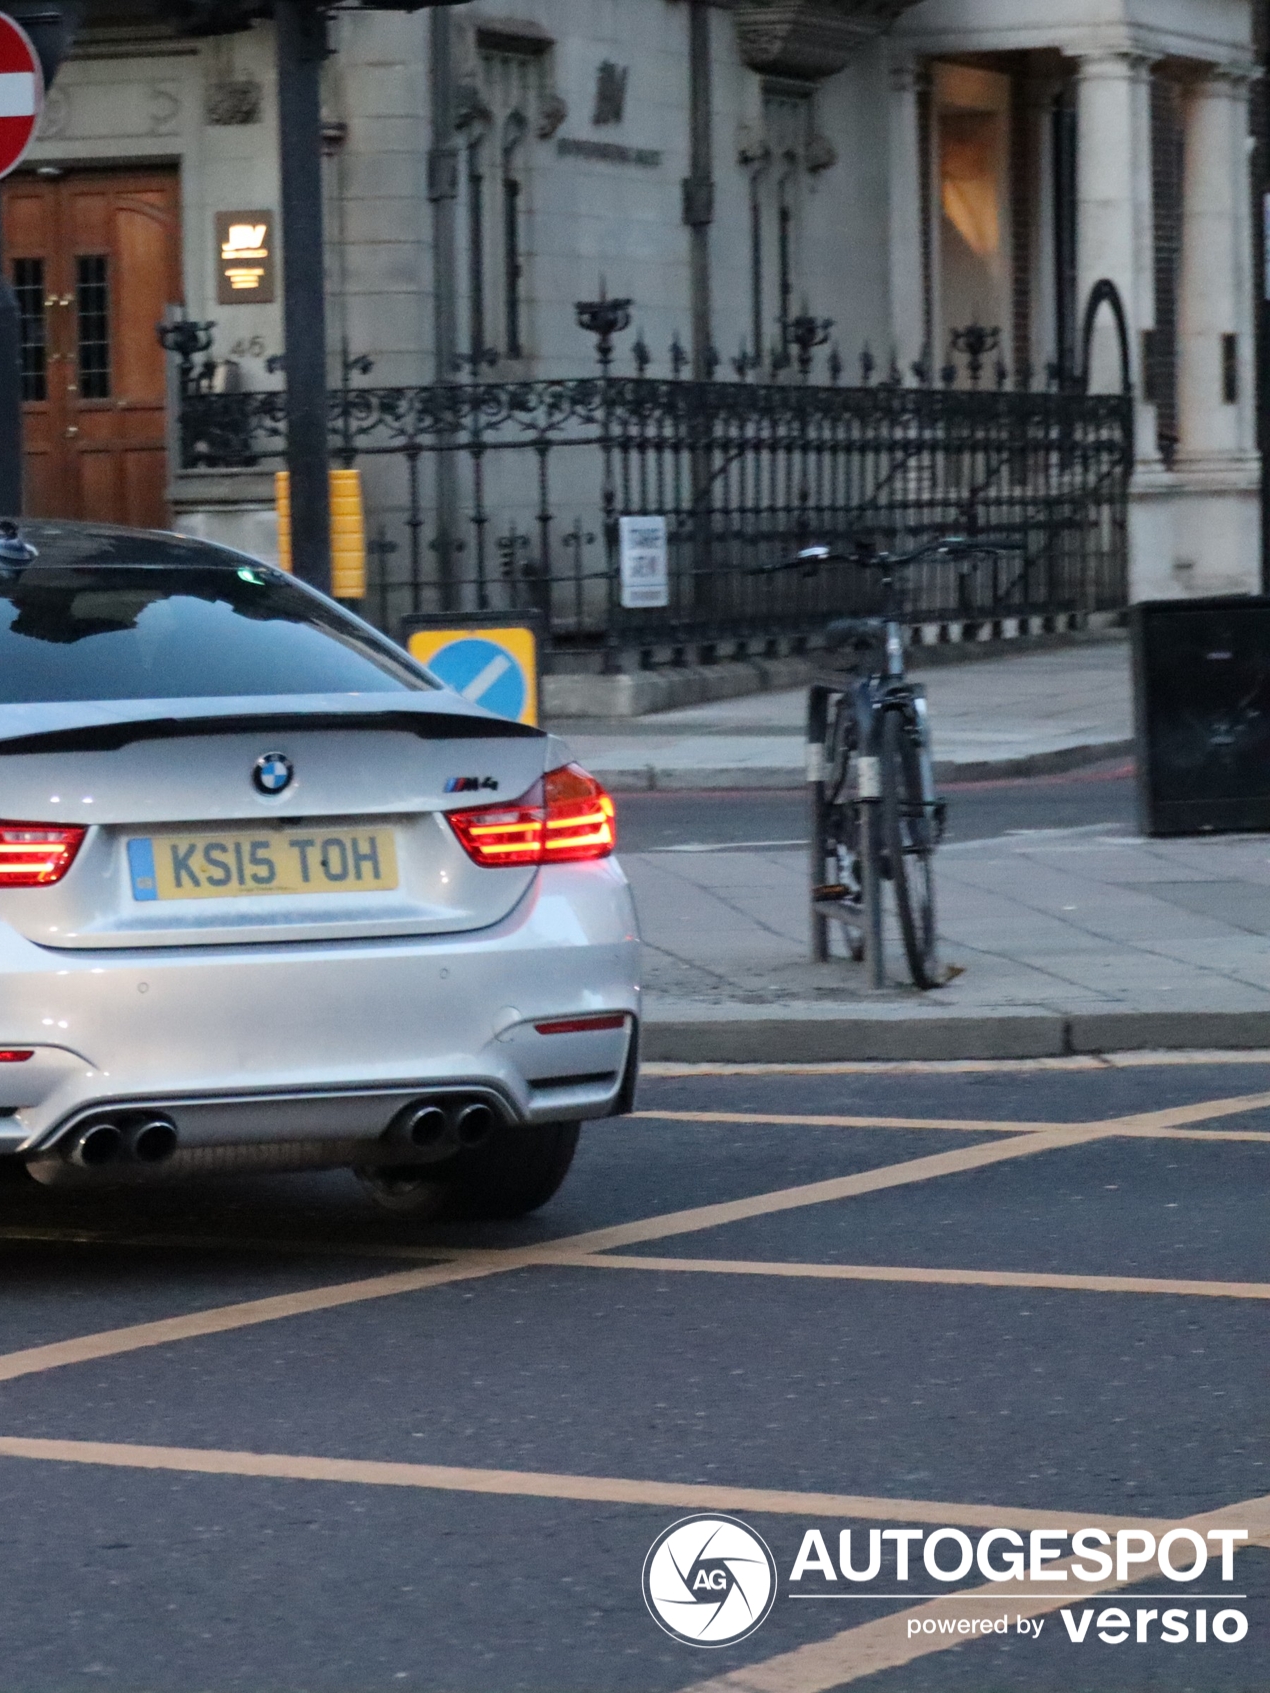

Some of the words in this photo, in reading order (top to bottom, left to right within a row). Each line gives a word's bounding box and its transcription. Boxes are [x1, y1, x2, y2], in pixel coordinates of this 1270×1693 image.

[445, 776, 498, 793] M4
[170, 841, 277, 888] KS15
[289, 836, 381, 882] TOH
